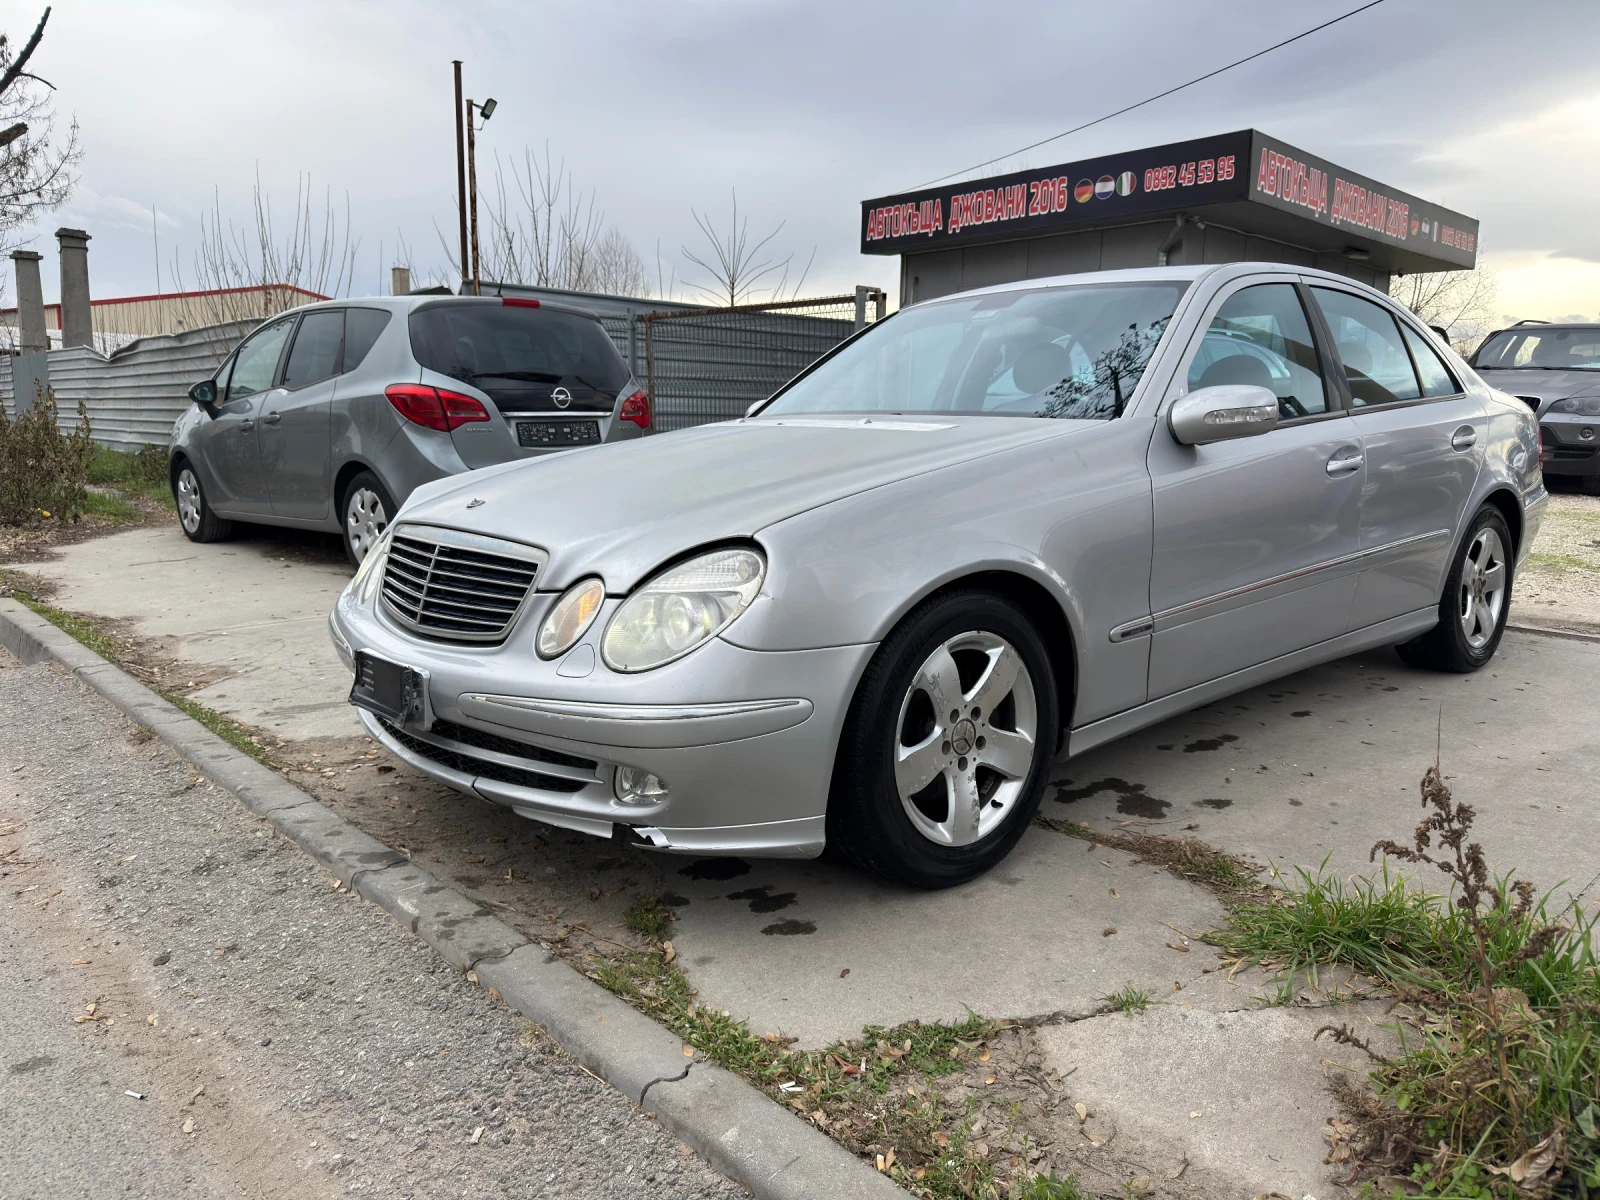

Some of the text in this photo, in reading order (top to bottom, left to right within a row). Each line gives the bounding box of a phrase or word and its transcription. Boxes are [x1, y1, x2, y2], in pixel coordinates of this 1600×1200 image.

[1144, 155, 1235, 192] 0892 45 53 95
[1257, 148, 1409, 241] АВТОКЪЩА ДЖОВАНИ 2016
[866, 176, 1068, 240] АВТОКЪЩА ДЖОВАНИ 2016
